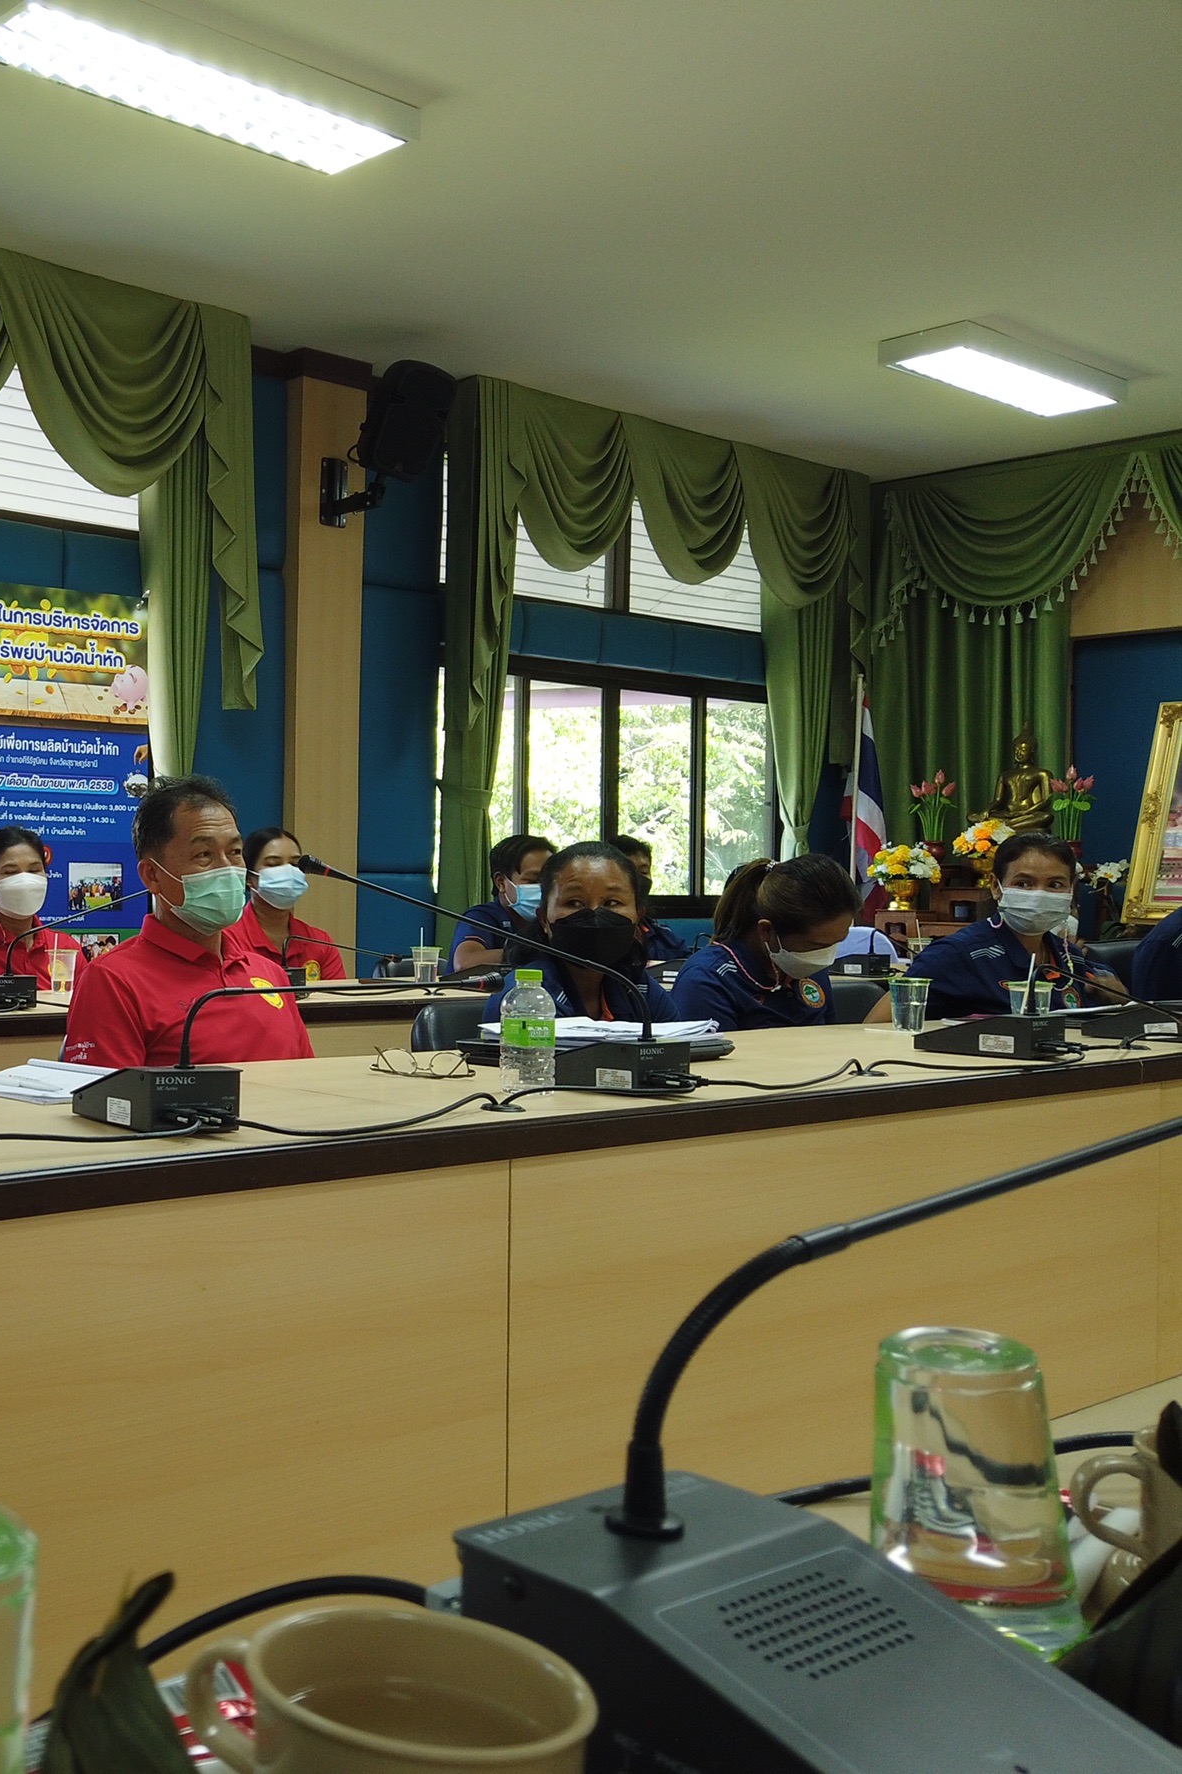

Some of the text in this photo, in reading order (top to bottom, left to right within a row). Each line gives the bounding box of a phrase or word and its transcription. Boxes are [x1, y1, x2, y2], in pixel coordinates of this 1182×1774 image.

[0, 776, 5, 785] 7
[7, 774, 28, 786] เดือน
[30, 775, 66, 788] กันยายน
[68, 780, 87, 789] พ.ศ.
[90, 781, 113, 790] 2538
